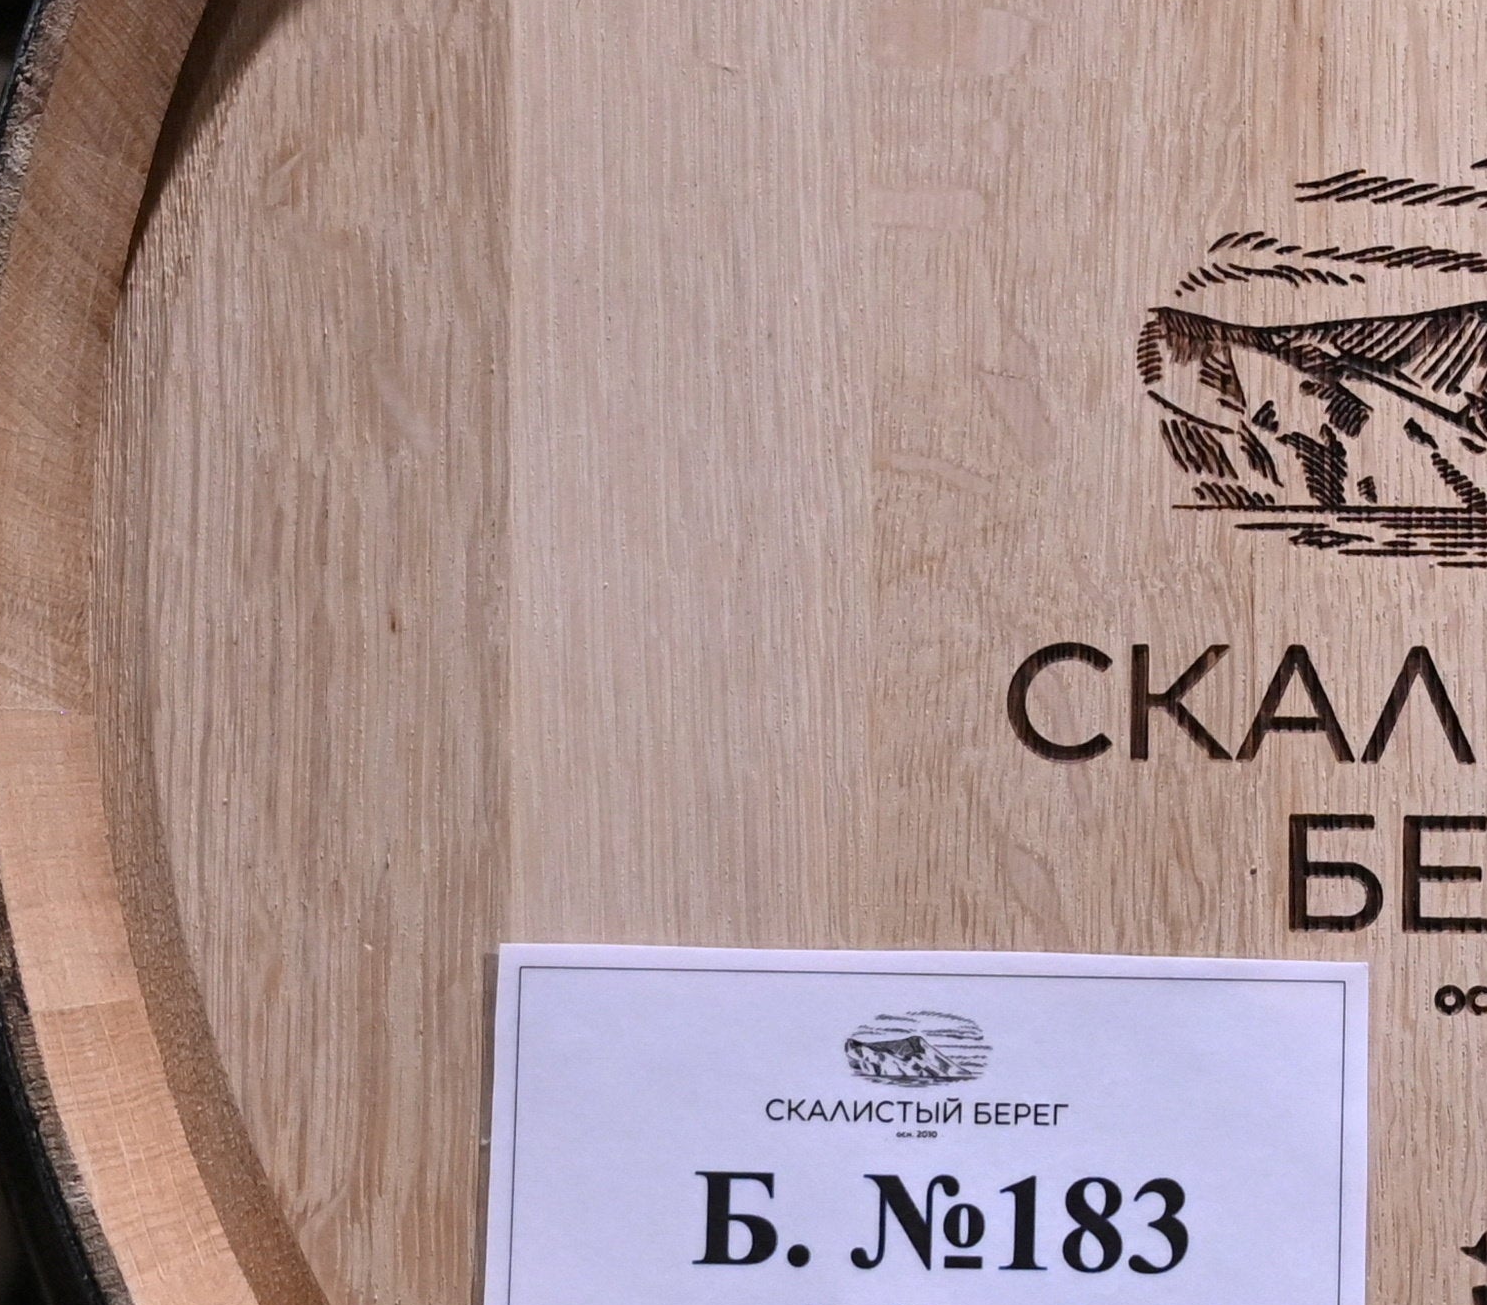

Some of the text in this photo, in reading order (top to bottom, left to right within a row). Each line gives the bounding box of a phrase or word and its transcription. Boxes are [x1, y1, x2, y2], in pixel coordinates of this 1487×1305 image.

[765, 1097, 1069, 1126] СКАЛИСТЫЙ БЕРЕГ
[915, 1129, 938, 1139] 2010
[692, 1171, 1189, 1275] Б. №183
